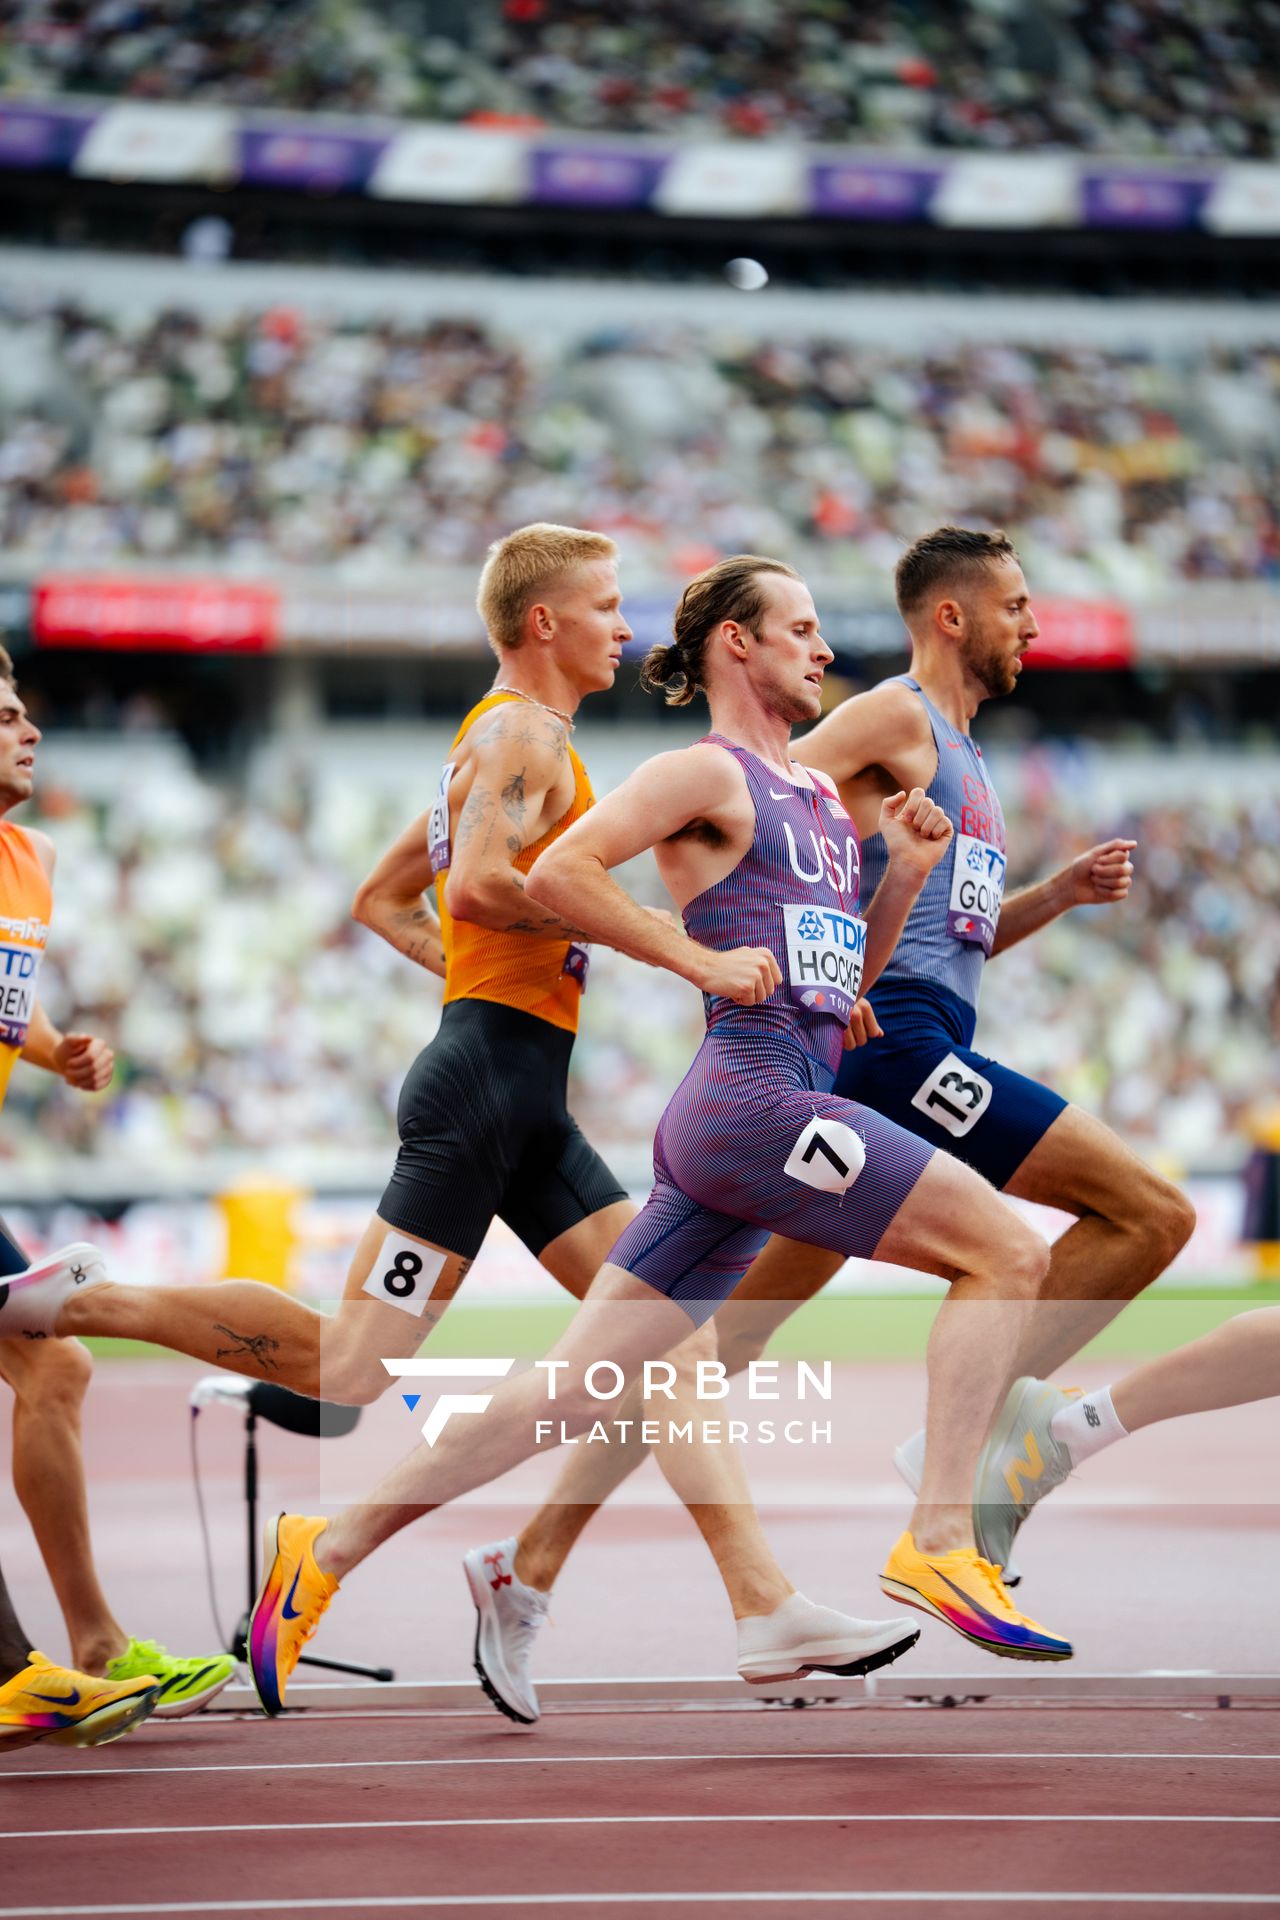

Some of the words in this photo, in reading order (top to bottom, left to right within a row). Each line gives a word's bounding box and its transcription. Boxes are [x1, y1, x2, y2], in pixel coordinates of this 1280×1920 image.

[783, 821, 860, 894] USA
[823, 912, 868, 957] TDK
[797, 950, 863, 997] HOCKE
[829, 993, 851, 1016] TOKY
[926, 1071, 983, 1123] 13
[801, 1131, 850, 1179] 7
[384, 1251, 423, 1297] 8
